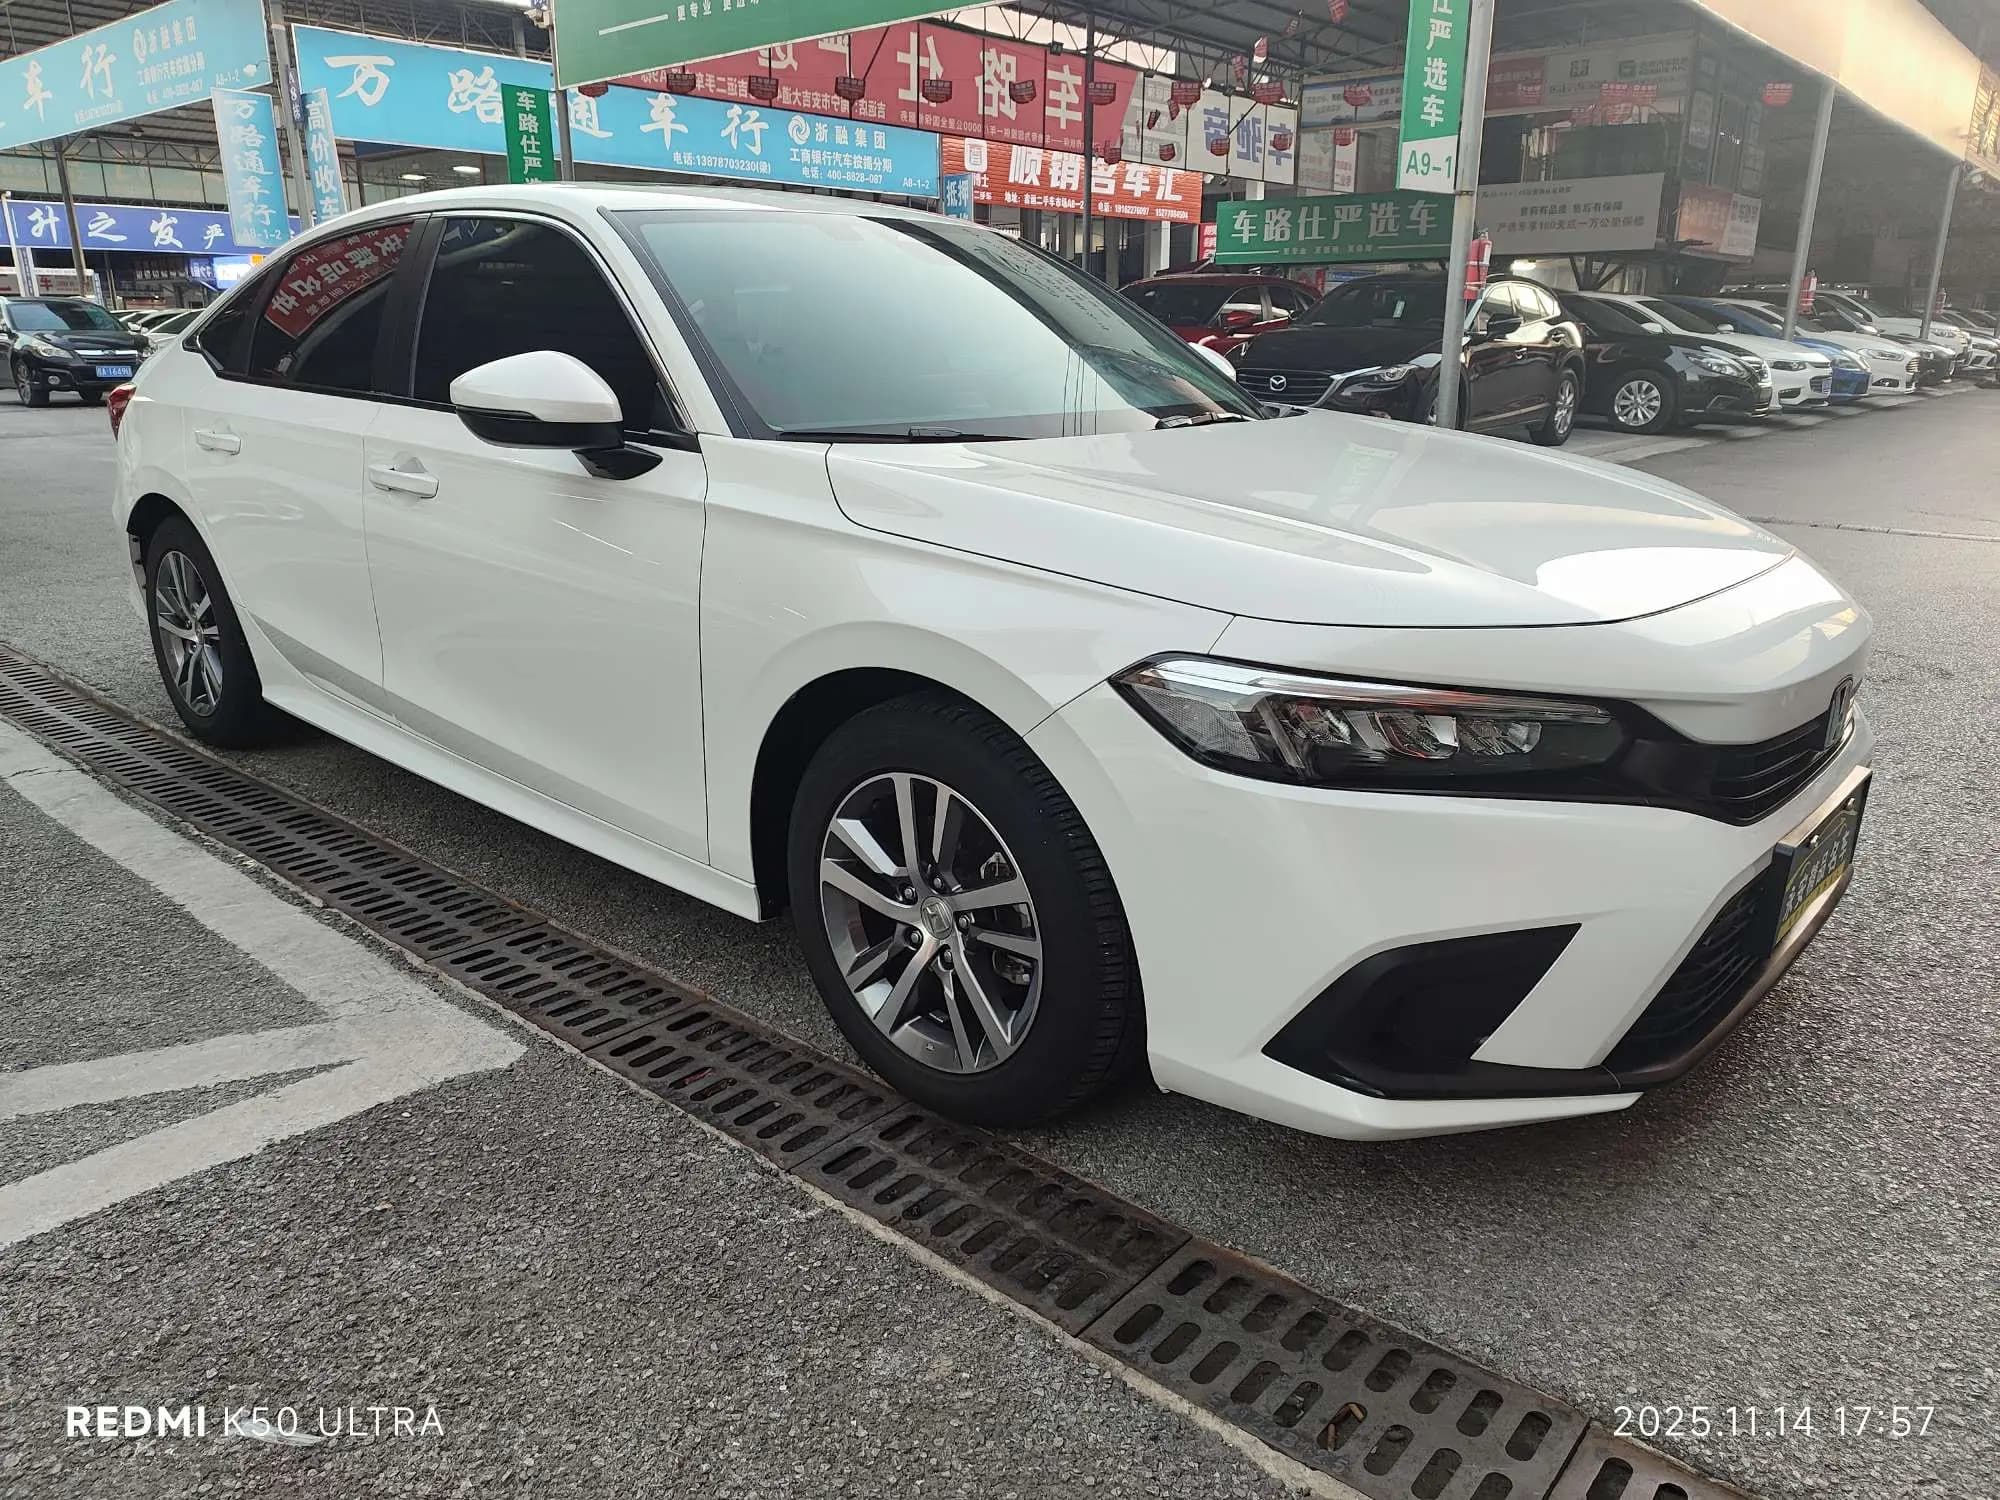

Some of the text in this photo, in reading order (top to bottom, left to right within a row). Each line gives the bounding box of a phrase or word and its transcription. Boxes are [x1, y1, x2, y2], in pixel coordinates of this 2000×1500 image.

[815, 122, 886, 151] 浙融集团
[790, 148, 893, 174] 工商银行汽车按揭分期
[1405, 149, 1453, 179] A9-1
[1231, 199, 1439, 244] 车路仕严选车
